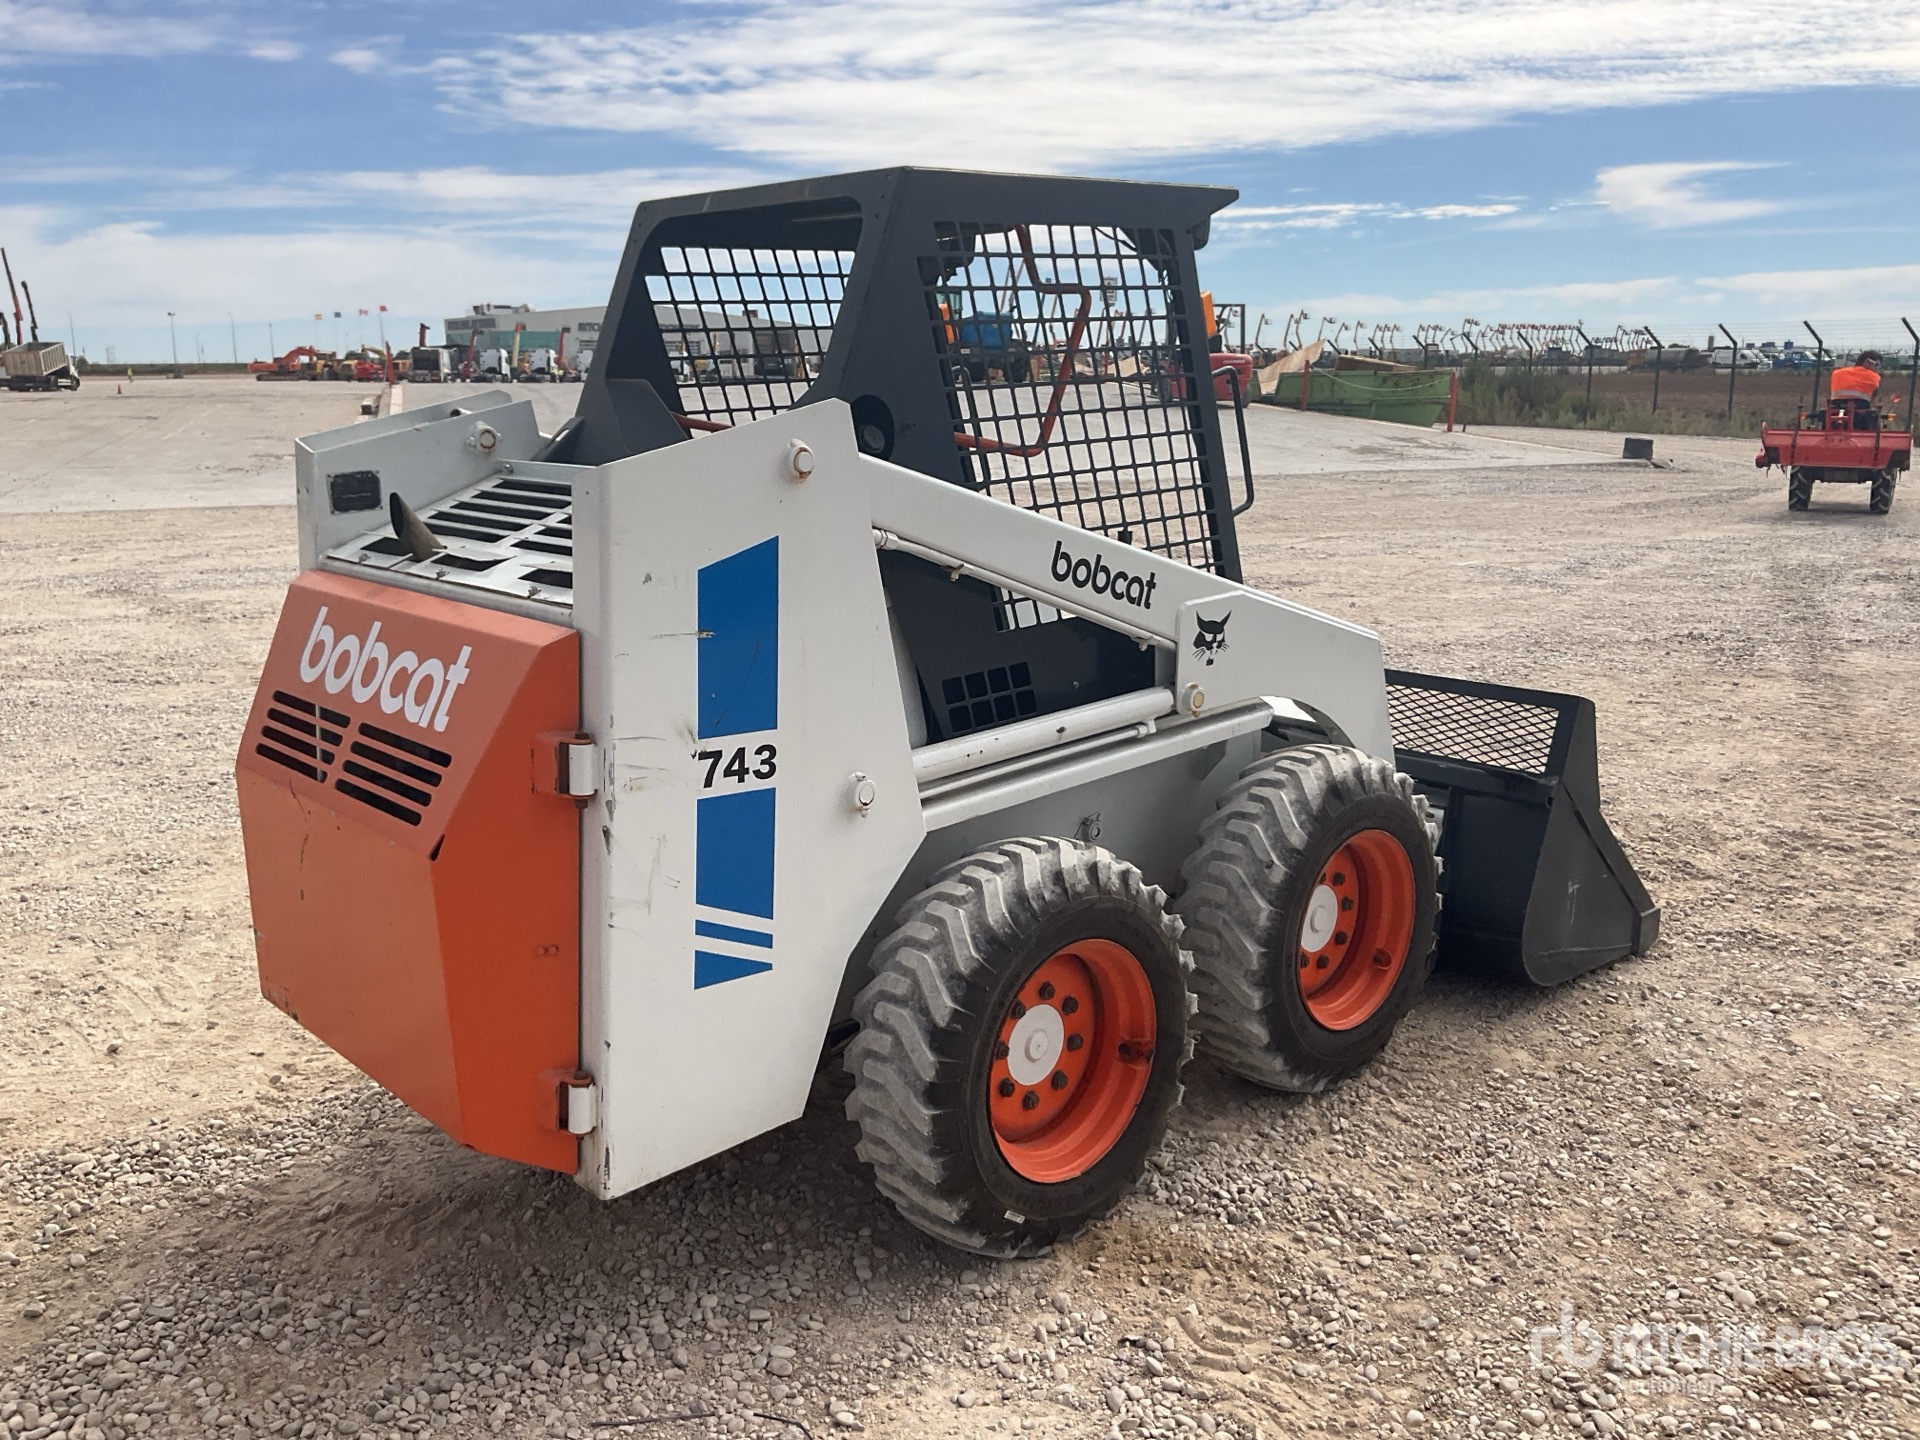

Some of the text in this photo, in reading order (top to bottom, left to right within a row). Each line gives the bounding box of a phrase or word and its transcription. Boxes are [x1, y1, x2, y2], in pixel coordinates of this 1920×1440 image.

[1051, 540, 1156, 609] bobcat
[300, 606, 472, 732] bobcat
[697, 744, 777, 788] 743
